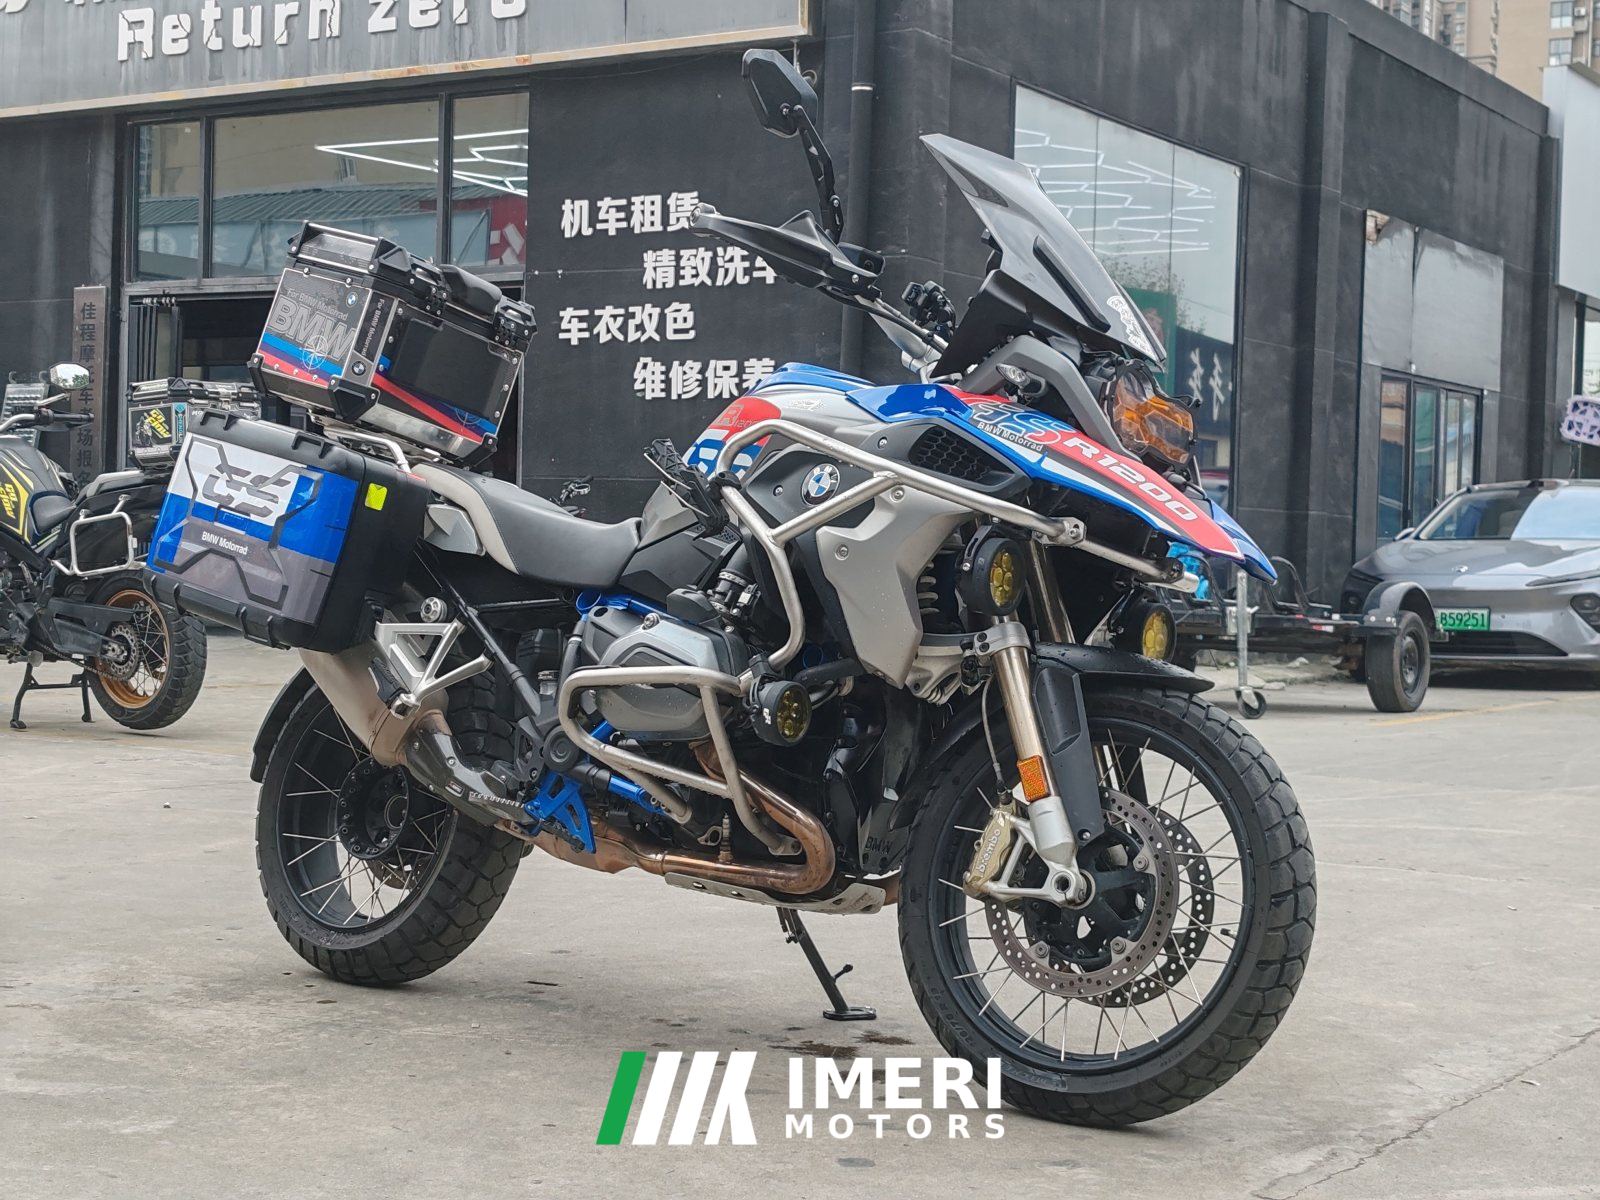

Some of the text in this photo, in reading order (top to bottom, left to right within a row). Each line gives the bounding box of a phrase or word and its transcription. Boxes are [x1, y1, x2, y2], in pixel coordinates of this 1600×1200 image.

[117, 0, 341, 61] Return
[561, 191, 699, 237] 机车租赁
[267, 294, 357, 361] BMW
[558, 302, 696, 345] 车衣改色
[977, 421, 1044, 452] BMW Motorrad
[201, 531, 249, 555] BMW Motorrad
